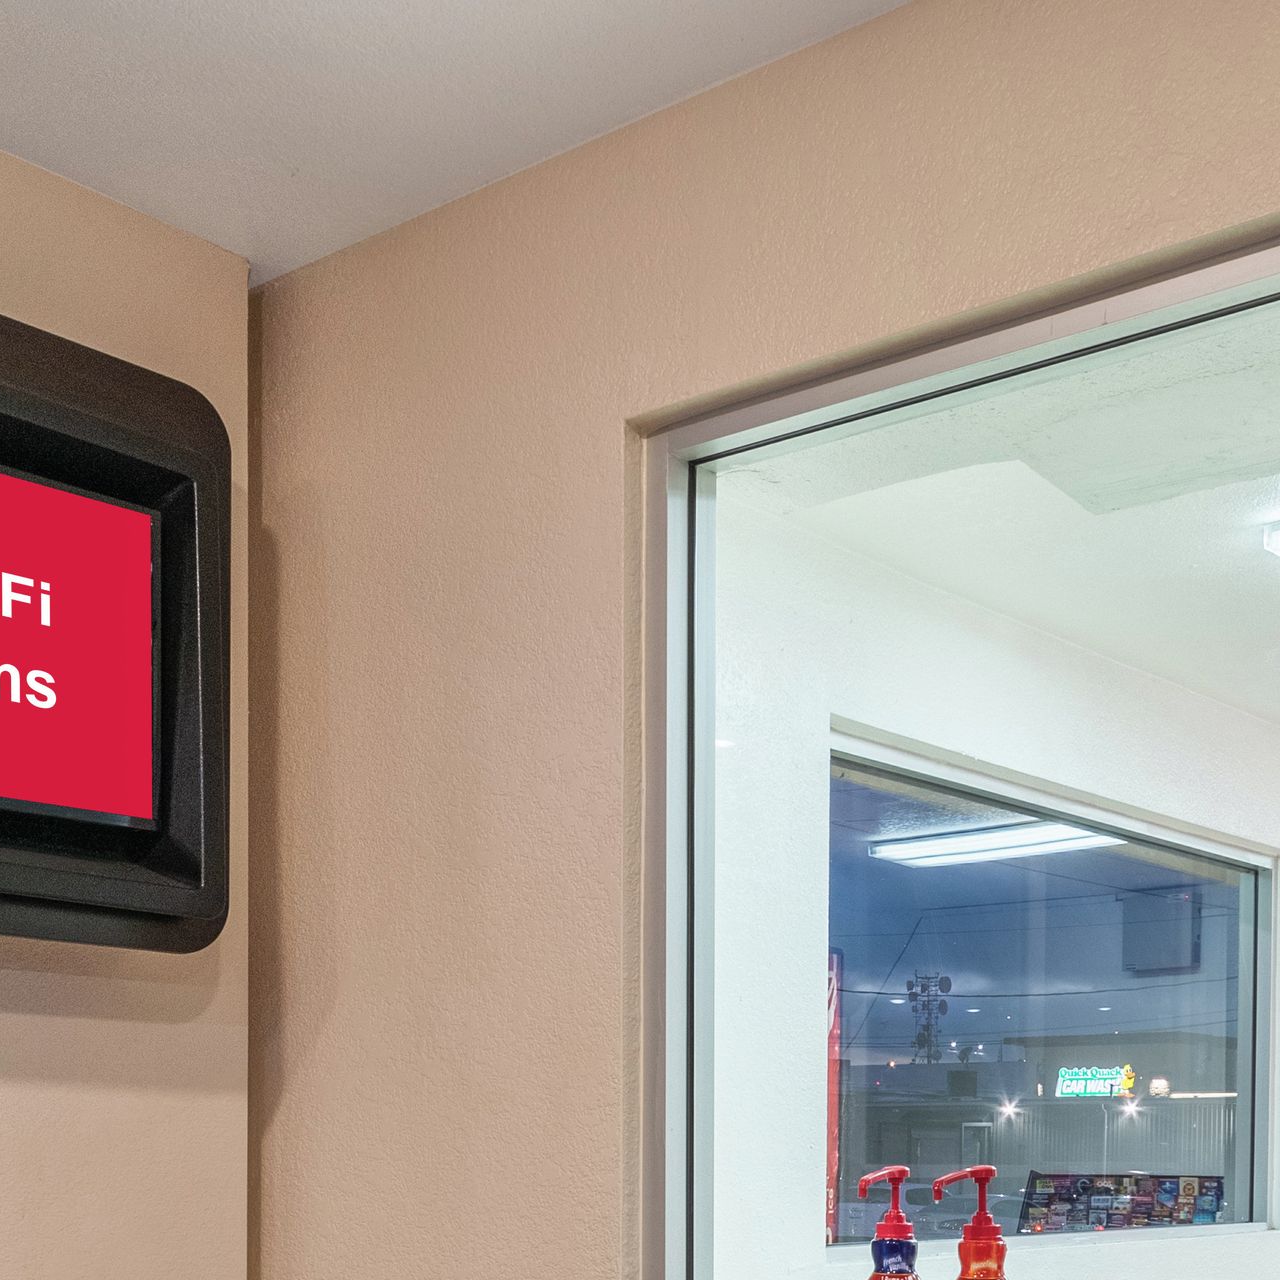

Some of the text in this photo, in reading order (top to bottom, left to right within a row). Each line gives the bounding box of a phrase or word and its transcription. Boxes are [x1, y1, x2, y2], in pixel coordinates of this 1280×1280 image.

[1060, 1067, 1122, 1078] Quick Quack
[1062, 1079, 1085, 1093] CAR
